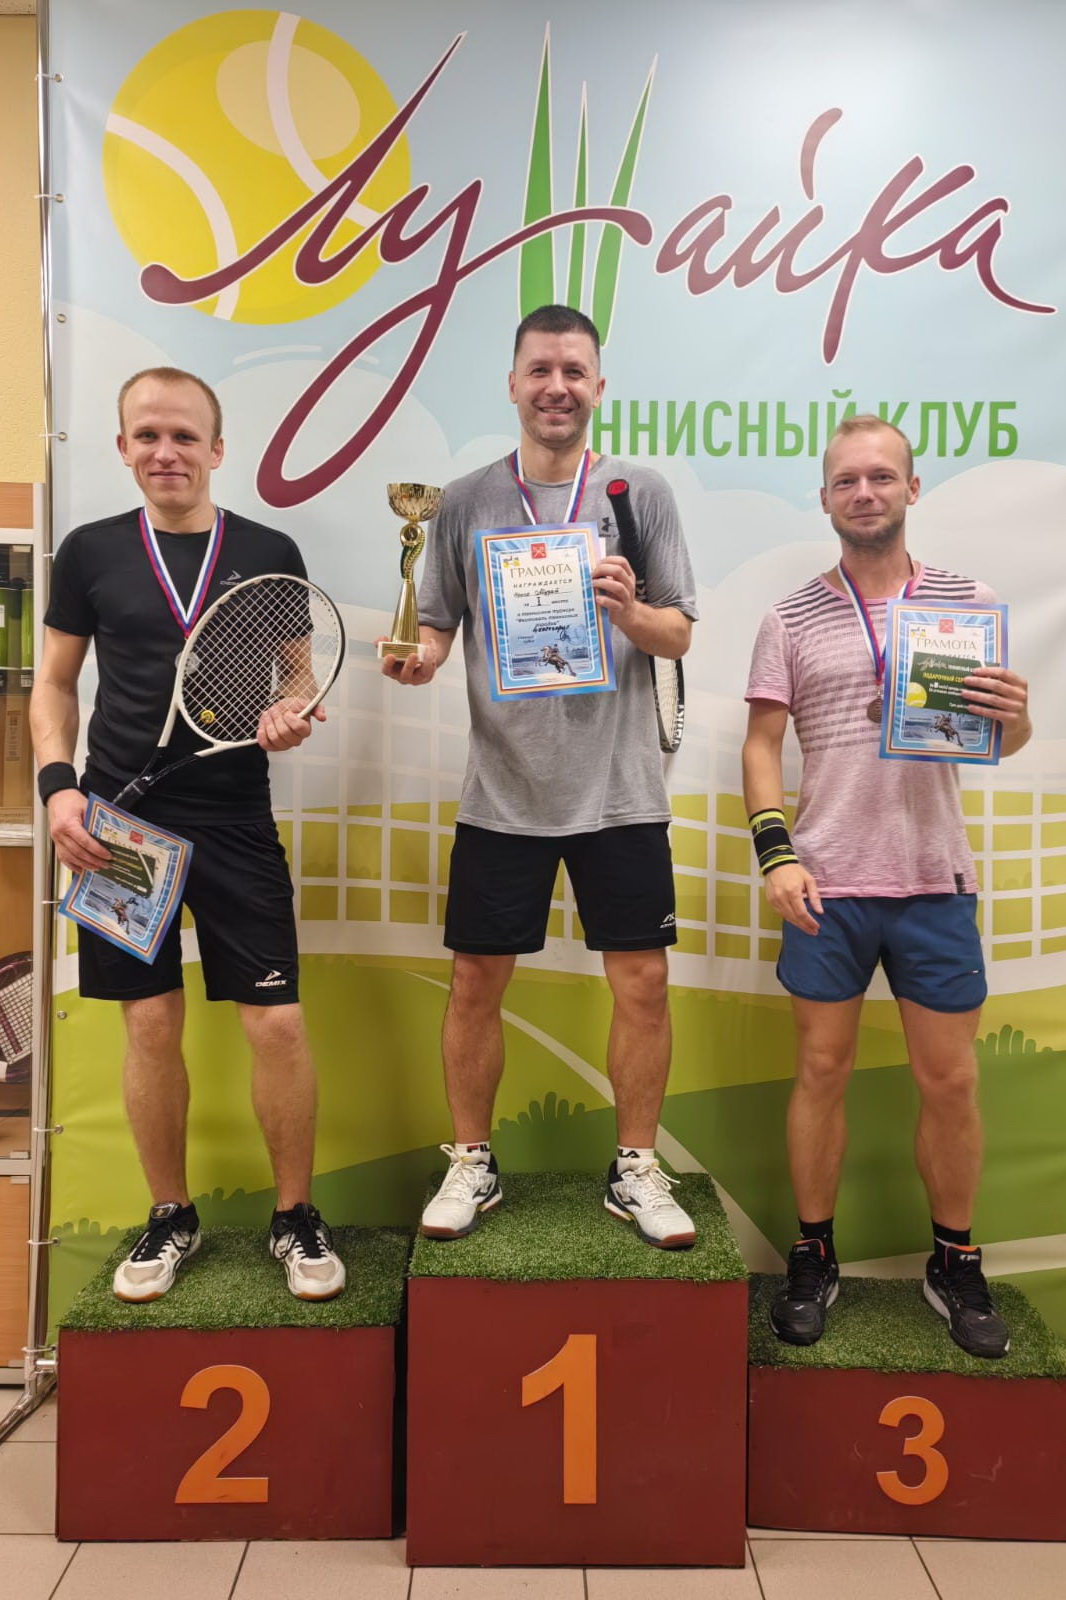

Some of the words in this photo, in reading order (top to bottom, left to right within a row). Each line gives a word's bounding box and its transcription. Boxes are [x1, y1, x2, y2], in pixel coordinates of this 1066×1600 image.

[593, 389, 857, 457] ННИСНЫЙ
[510, 563, 572, 578] ГРАМОТА
[513, 578, 573, 588] НАГРАЖДАЕТСЯ
[916, 638, 977, 650] ГРАМОТА
[467, 1143, 491, 1153] FIL
[617, 1148, 641, 1158] ILA
[520, 1333, 597, 1504] 1
[174, 1364, 271, 1504] 2
[876, 1395, 949, 1506] 3
